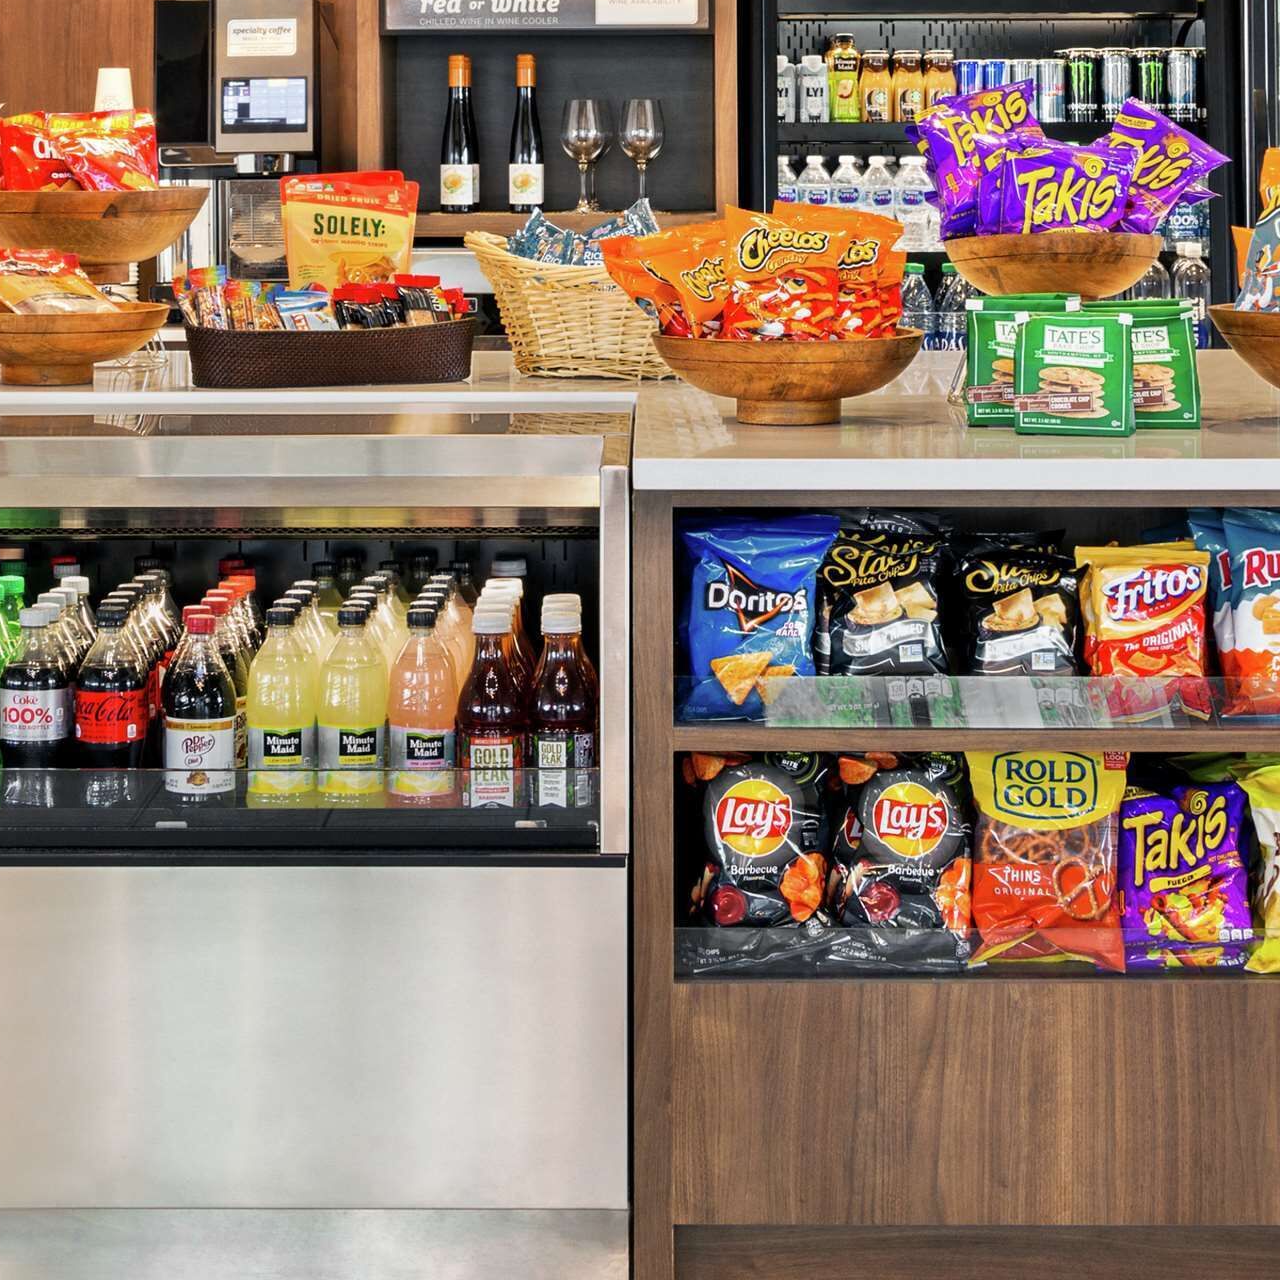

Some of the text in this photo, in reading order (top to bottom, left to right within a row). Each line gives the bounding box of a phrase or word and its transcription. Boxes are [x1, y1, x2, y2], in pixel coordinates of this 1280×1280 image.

[469, 0, 484, 9] or
[420, 17, 456, 25] CHILLED
[232, 26, 292, 35] specialty coffee
[1018, 166, 1119, 233] Takis
[740, 227, 830, 272] Cheetos
[1048, 328, 1100, 344] TATE'S
[878, 563, 905, 581] Chips
[1020, 572, 1048, 586] Chips
[708, 582, 807, 613] Doritos
[1102, 566, 1201, 620] Fritos
[1124, 618, 1195, 651] The ORIGINAL
[1272, 675, 1278, 683] &
[13, 694, 39, 705] Coke
[3, 707, 52, 723] 100%
[182, 738, 213, 754] Pepper
[193, 735, 205, 745] Dr
[266, 734, 299, 746] Minute
[342, 734, 375, 746] Minute
[409, 738, 442, 749] Minute
[271, 743, 295, 754] Maid
[347, 743, 371, 753] Maid
[414, 747, 438, 757] Maid
[541, 743, 562, 754] GOLD
[474, 747, 509, 764] GOLD
[541, 753, 562, 764] PEAK
[474, 766, 509, 782] PEAK
[1006, 759, 1087, 784] ROLD
[1003, 784, 1088, 808] GOLD
[722, 798, 786, 838] Lay's
[879, 800, 943, 840] Lay's
[1123, 795, 1227, 886] Takis
[730, 864, 778, 876] Barbecue
[888, 864, 934, 876] Barbecue
[1001, 868, 1042, 883] THINS
[1167, 874, 1194, 886] FUEGO
[994, 887, 1053, 896] ORIGINAL
